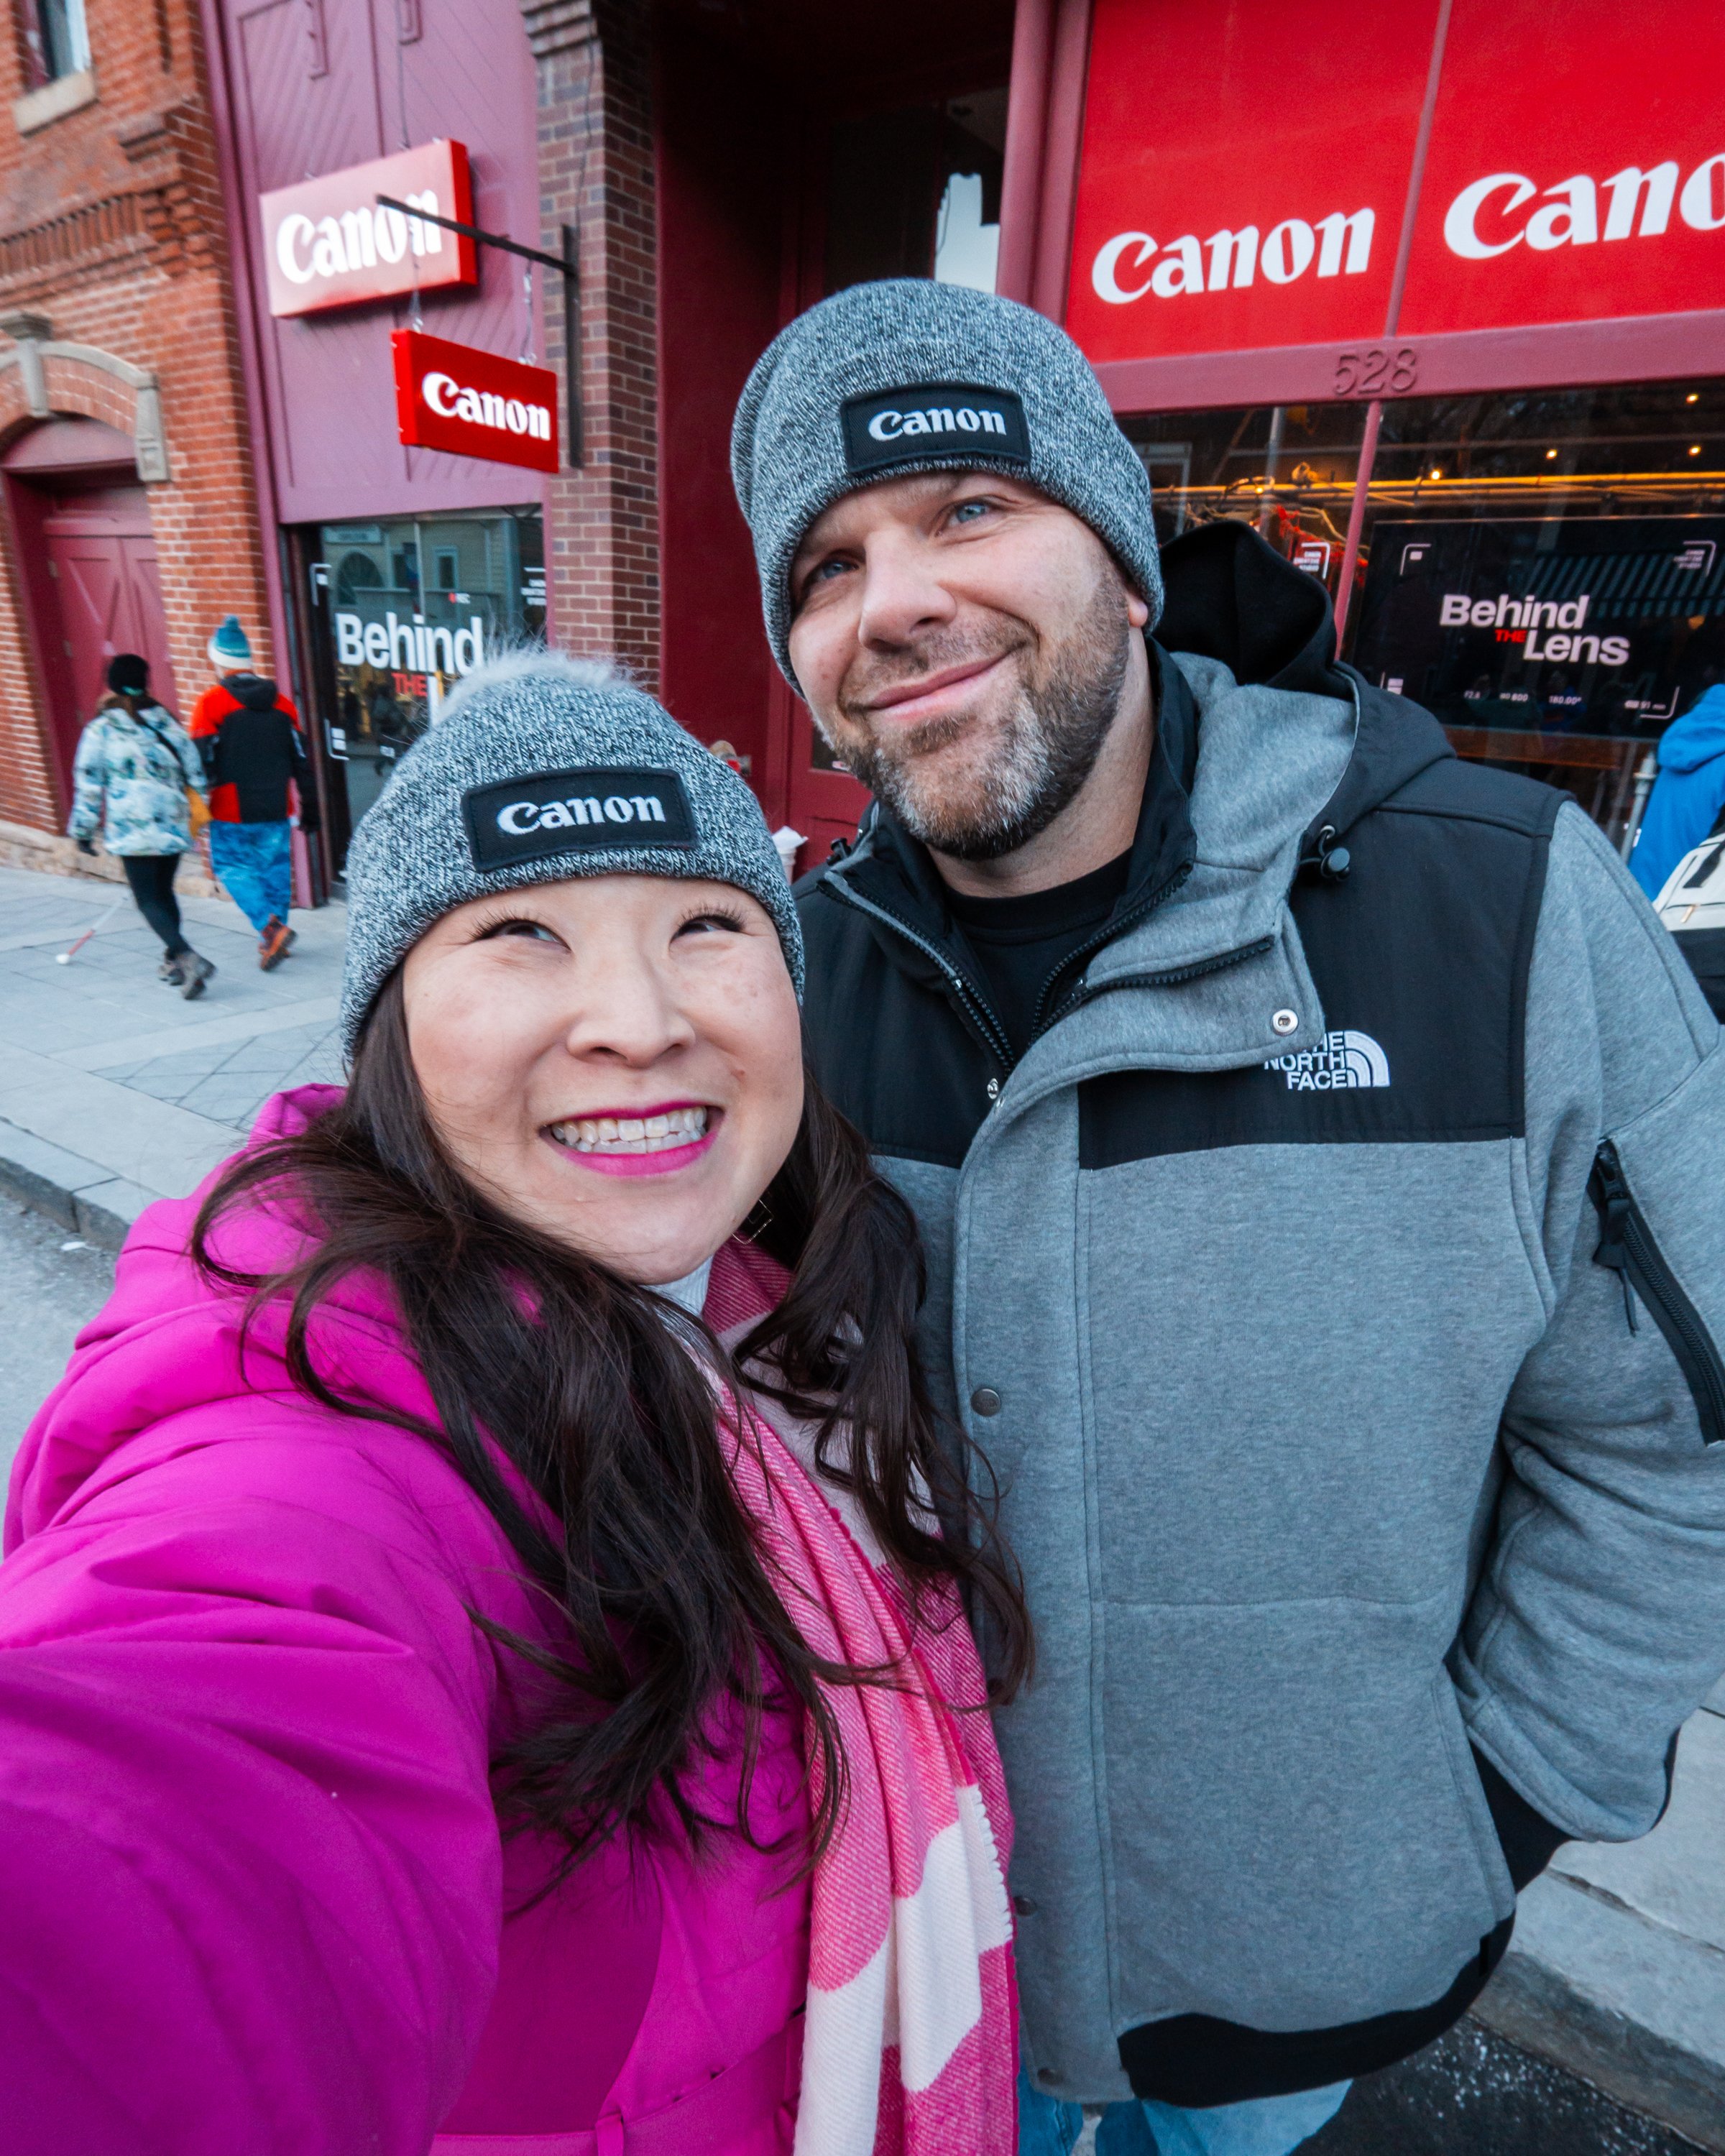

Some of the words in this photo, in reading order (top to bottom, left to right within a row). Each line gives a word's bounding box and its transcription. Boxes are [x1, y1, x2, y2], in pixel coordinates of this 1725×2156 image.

[1443, 153, 1725, 259] Cano
[277, 189, 442, 284] Canon
[1092, 208, 1375, 304] Canon
[1333, 348, 1418, 396] 528
[422, 372, 551, 441] Canon
[868, 407, 1006, 441] Canon
[1440, 594, 1590, 629] Behind
[336, 612, 483, 676] Behind
[1495, 629, 1527, 643] THE
[1523, 630, 1630, 665] Lens
[391, 672, 428, 697] THE
[497, 796, 666, 835] Canon
[1287, 1069, 1348, 1091] FACE
